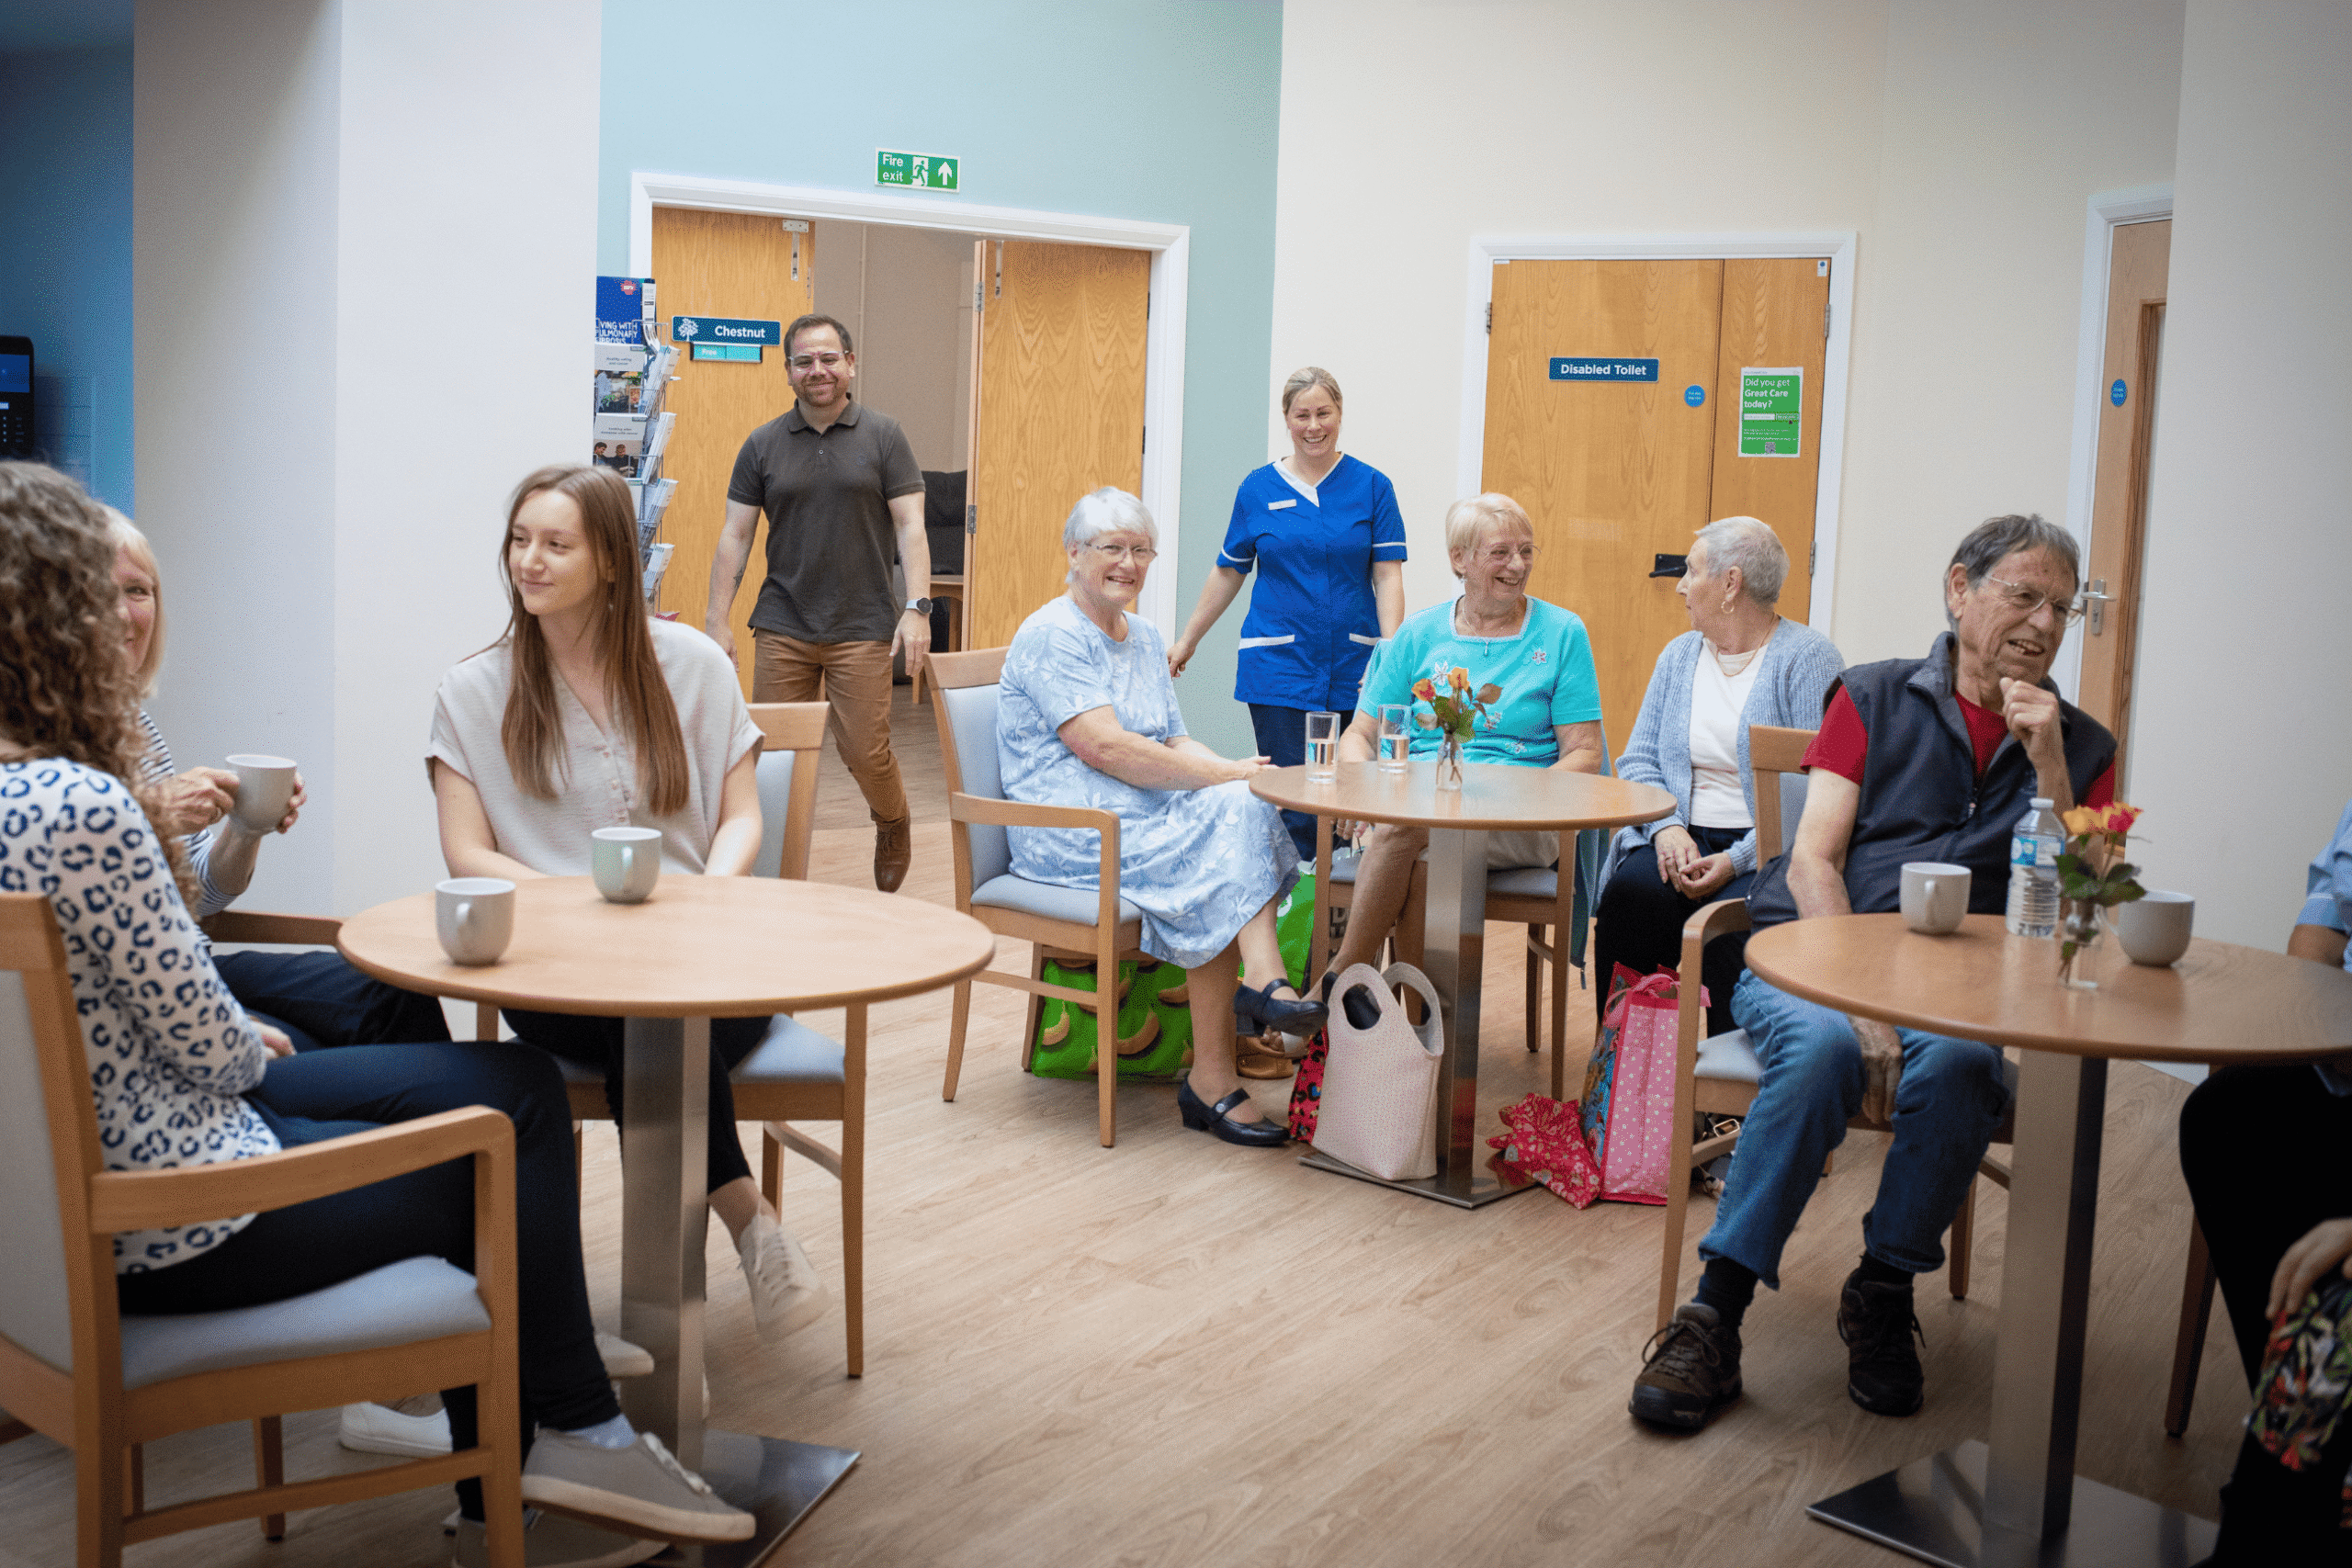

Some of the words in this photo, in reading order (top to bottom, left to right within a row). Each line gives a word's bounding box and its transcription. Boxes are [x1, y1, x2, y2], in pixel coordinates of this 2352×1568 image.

[882, 153, 903, 167] Fire
[882, 171, 903, 182] exit
[714, 325, 765, 339] Chestnut
[1560, 364, 1611, 375] Disabled
[1614, 365, 1647, 376] Toilet
[1745, 378, 1759, 387] Did
[1760, 379, 1775, 389] you
[1777, 378, 1790, 389] get
[1744, 389, 1768, 398] Great
[1769, 389, 1789, 398] Care
[1744, 400, 1773, 411] today?
